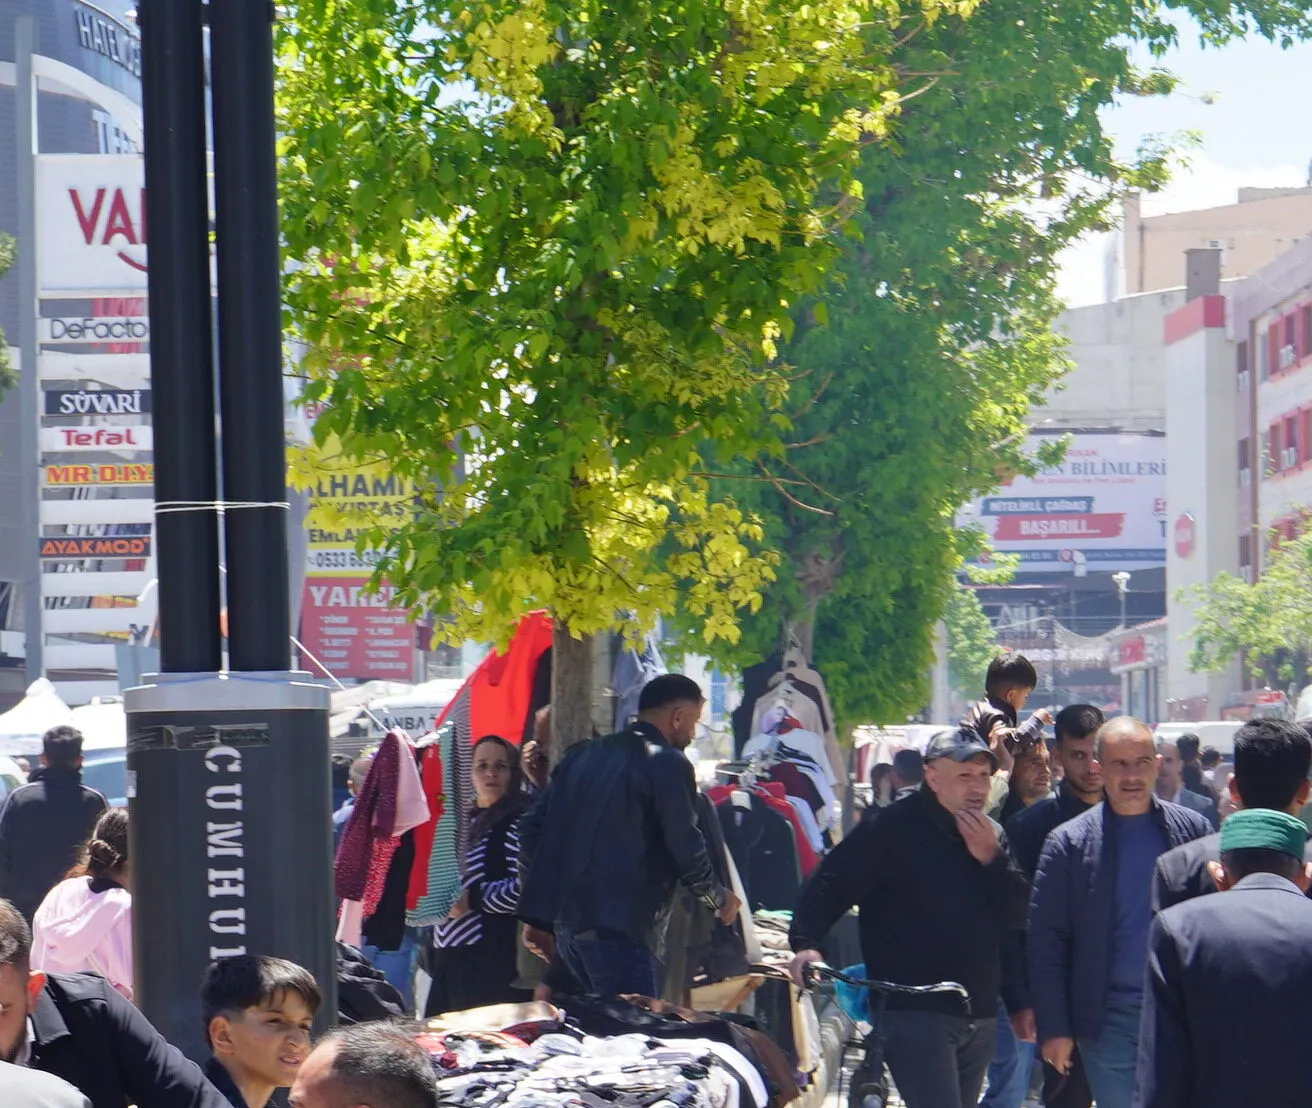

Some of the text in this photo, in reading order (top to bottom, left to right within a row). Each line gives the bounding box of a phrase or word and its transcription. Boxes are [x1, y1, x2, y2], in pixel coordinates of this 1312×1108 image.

[69, 188, 146, 245] VA
[51, 318, 147, 339] DeFacto
[59, 390, 141, 414] SÜVARİ
[61, 428, 138, 446] Tefal
[1071, 459, 1166, 476] BİLİMLERİ
